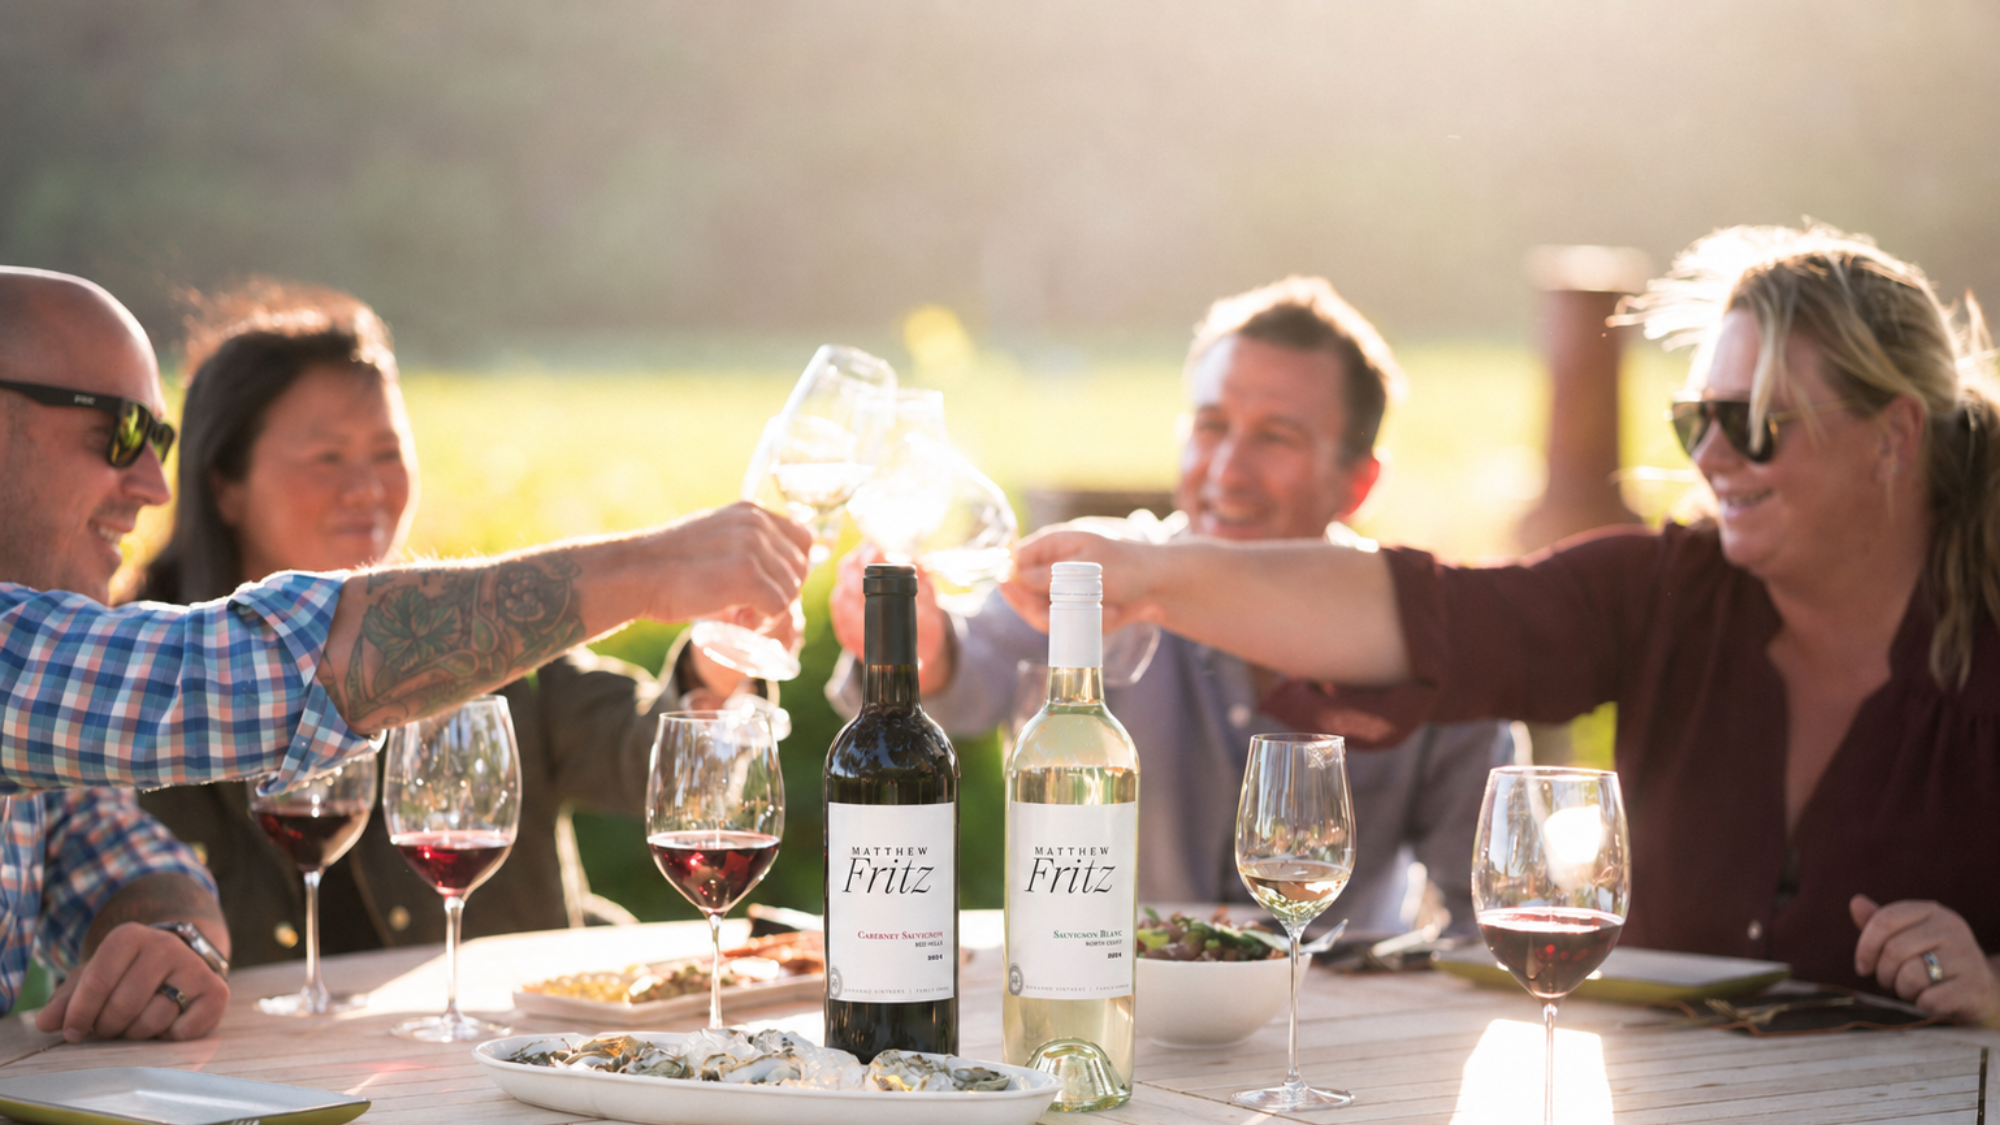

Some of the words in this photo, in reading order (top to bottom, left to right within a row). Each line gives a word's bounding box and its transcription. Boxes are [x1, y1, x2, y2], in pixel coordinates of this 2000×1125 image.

[852, 846, 928, 856] MATTHEW
[1034, 846, 1110, 856] MATTHEW
[842, 857, 935, 895] Fritz
[1024, 857, 1116, 894] Fritz
